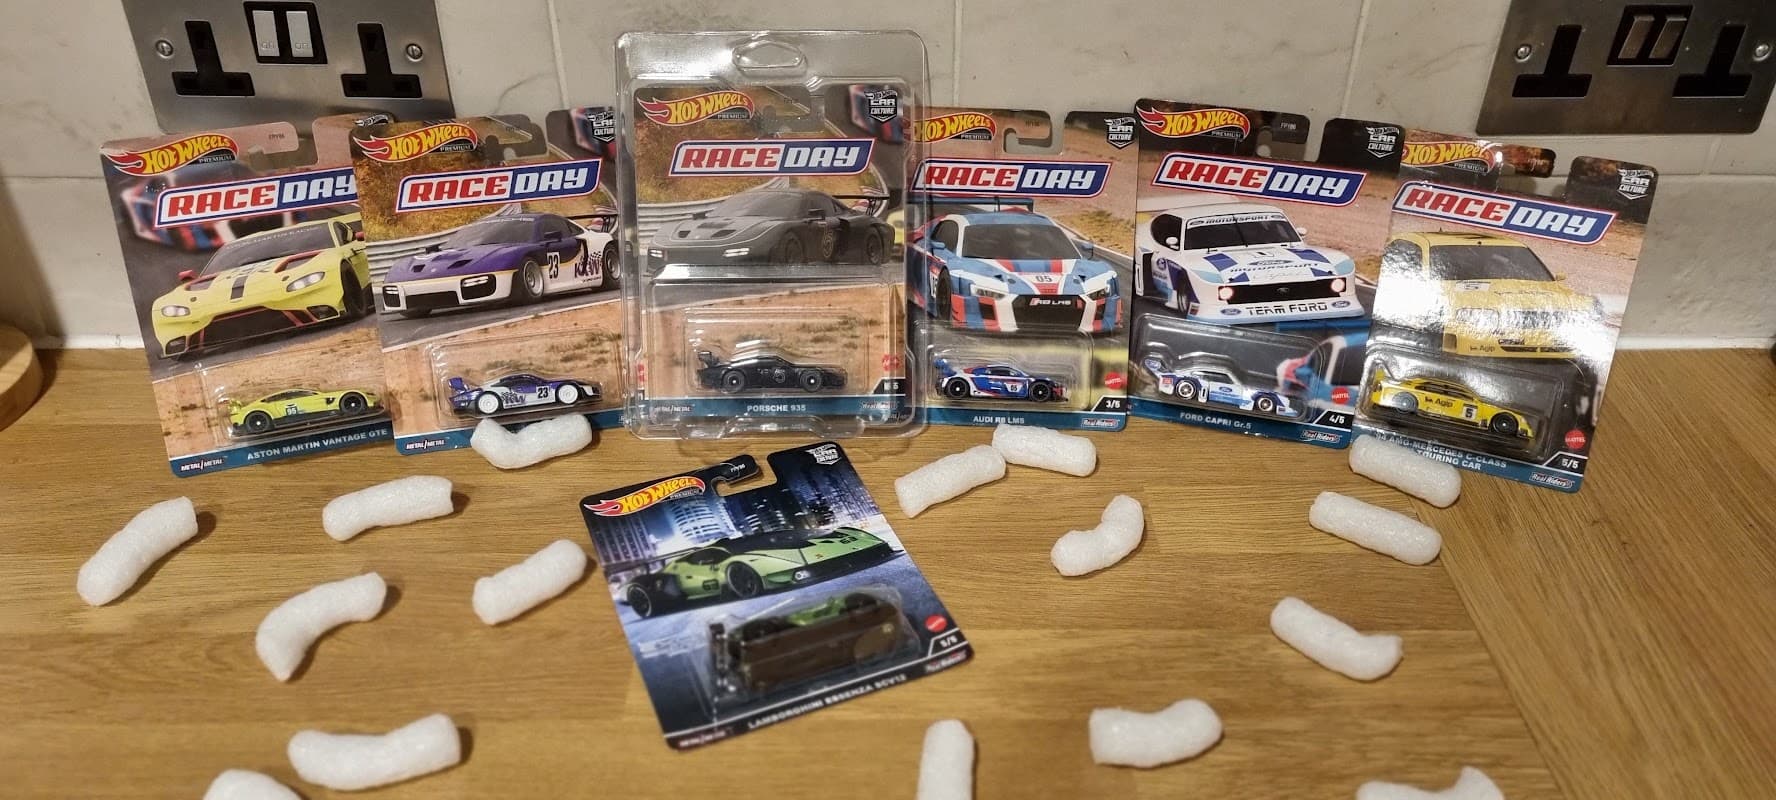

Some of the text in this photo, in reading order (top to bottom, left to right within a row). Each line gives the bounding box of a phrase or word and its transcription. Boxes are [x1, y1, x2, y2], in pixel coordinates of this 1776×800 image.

[668, 101, 700, 123] HOT
[1164, 114, 1196, 136] HOT
[388, 134, 423, 160] HOT
[680, 146, 860, 168] RACE DAY
[1368, 142, 1394, 151] CULTURE
[142, 149, 178, 174] HOT
[408, 168, 588, 203] RACE DAY
[926, 166, 1096, 190] RACE DAY
[1166, 160, 1350, 198] RACE DAY
[1619, 184, 1648, 194] CULTURE
[1621, 176, 1650, 186] CAR
[168, 174, 358, 218] RACE DAY
[1206, 214, 1270, 224] MOTORSPORT
[1404, 188, 1598, 236] RACE DAY
[548, 255, 558, 278] 23
[1245, 302, 1328, 316] TEAM FORD
[538, 387, 549, 398] 23
[287, 407, 296, 416] 95
[1180, 412, 1203, 422] FORD
[1205, 415, 1232, 426] CAPRI
[1329, 414, 1345, 424] 4/5
[1466, 408, 1473, 418] 5
[247, 428, 388, 461] ASTON MARTIN VANTAGE GTE
[1461, 459, 1481, 470] CAR
[1466, 453, 1507, 468] C-CLASS
[1562, 458, 1579, 468] 5/5
[618, 492, 652, 514] HOT
[748, 700, 824, 729] LAMBORGHINI
[824, 684, 874, 704] ESSENZA
